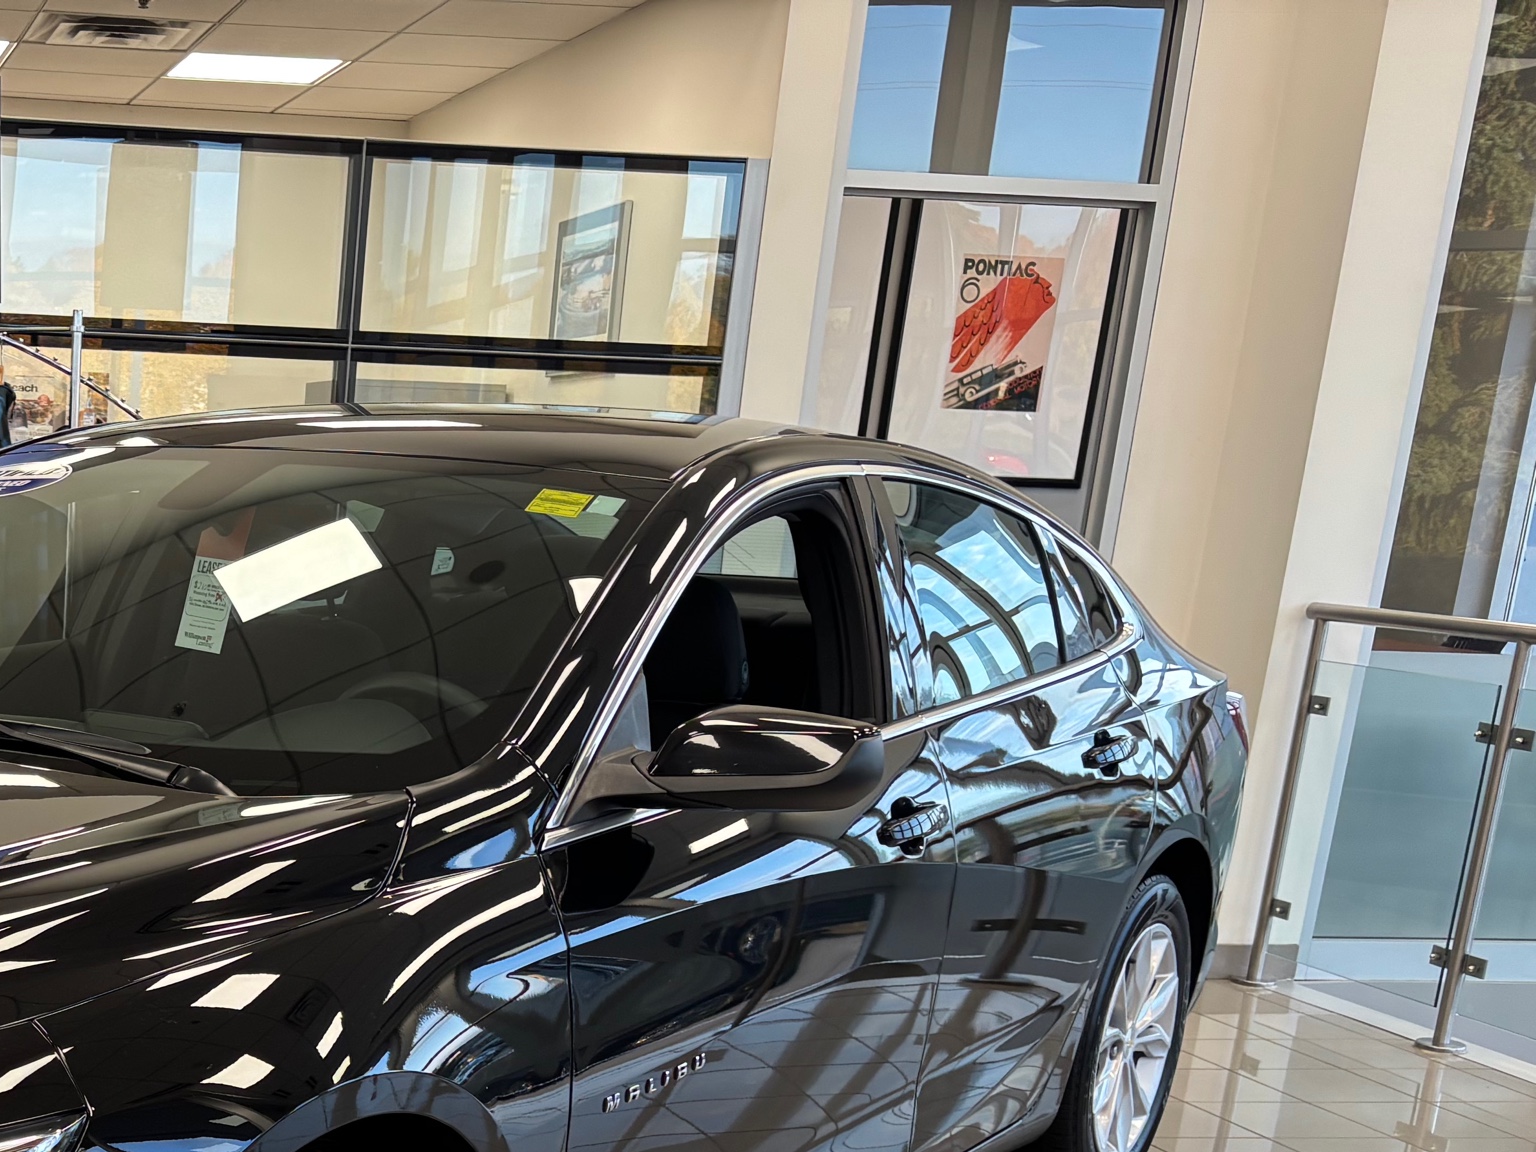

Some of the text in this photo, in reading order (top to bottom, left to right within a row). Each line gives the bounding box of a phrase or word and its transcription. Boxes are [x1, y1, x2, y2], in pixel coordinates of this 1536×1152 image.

[963, 258, 1037, 278] PONTIAC
[960, 277, 980, 304] 6
[12, 384, 38, 392] each
[602, 1052, 706, 1113] MALIBU
